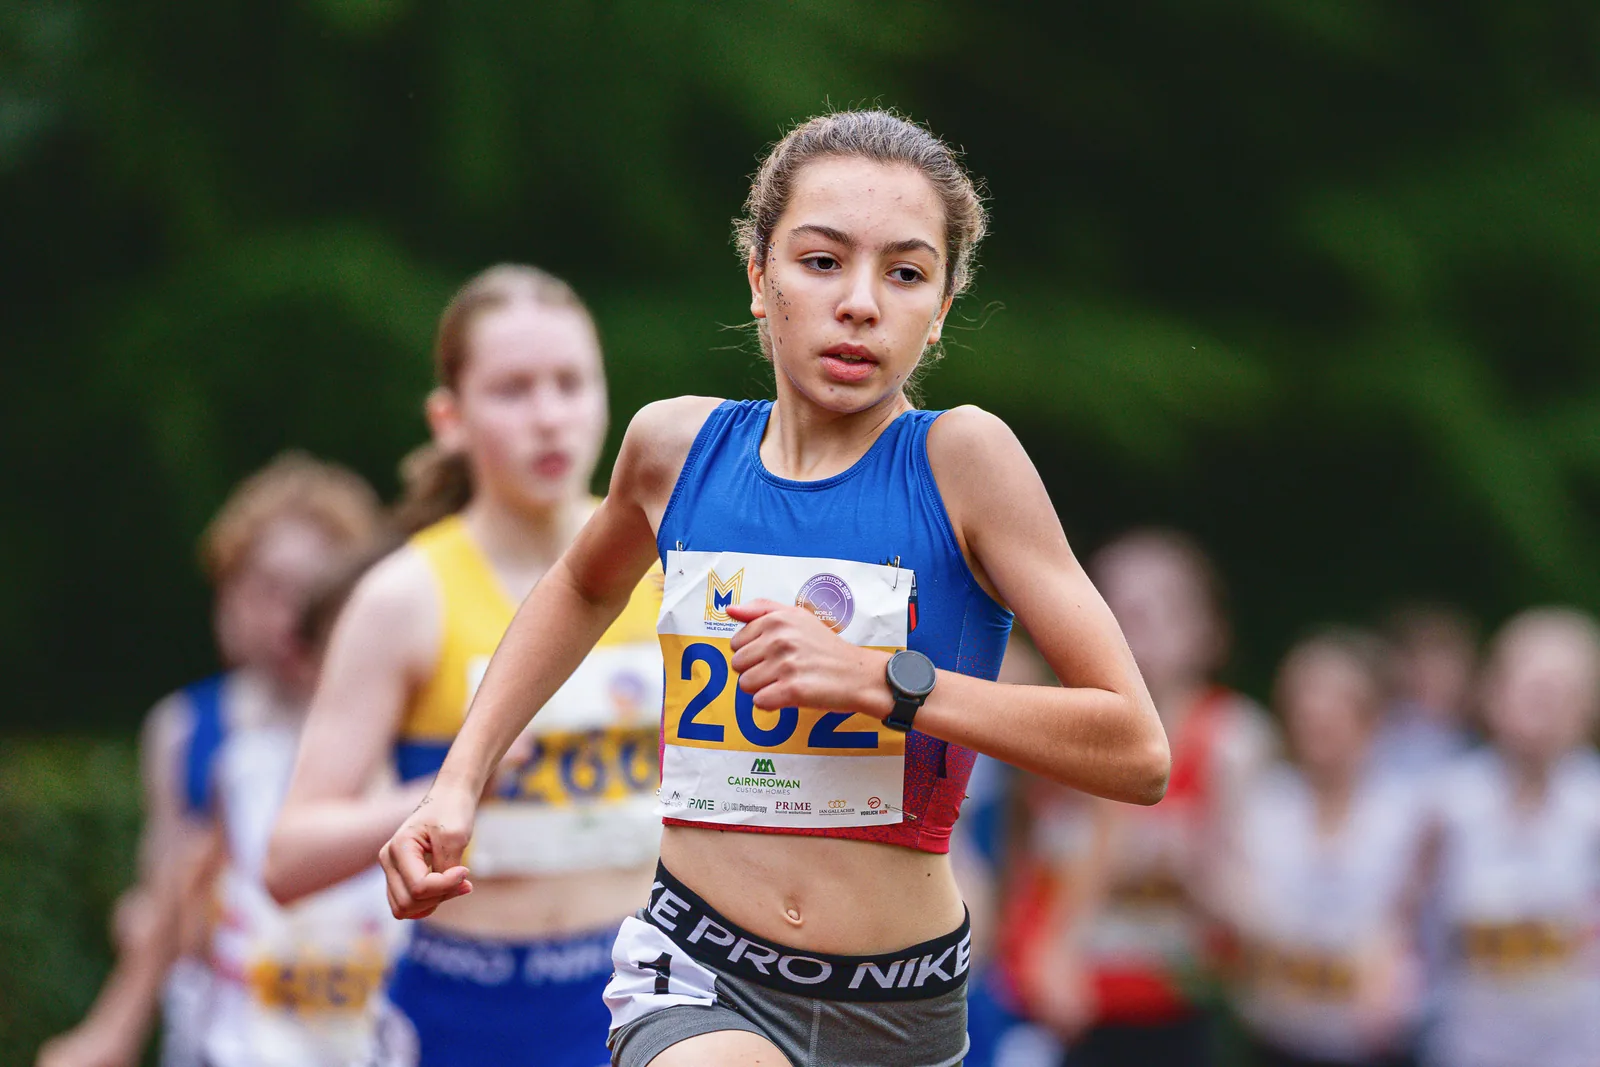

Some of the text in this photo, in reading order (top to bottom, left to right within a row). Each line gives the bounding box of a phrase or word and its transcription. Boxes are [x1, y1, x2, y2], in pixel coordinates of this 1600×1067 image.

[809, 576, 843, 587] COMPETITION
[727, 776, 801, 789] CAIRNROWAN
[766, 788, 791, 796] HOMES
[775, 801, 812, 811] PRIME
[687, 915, 833, 984] PRO
[848, 929, 971, 989] NIKE
[638, 952, 673, 995] 1
